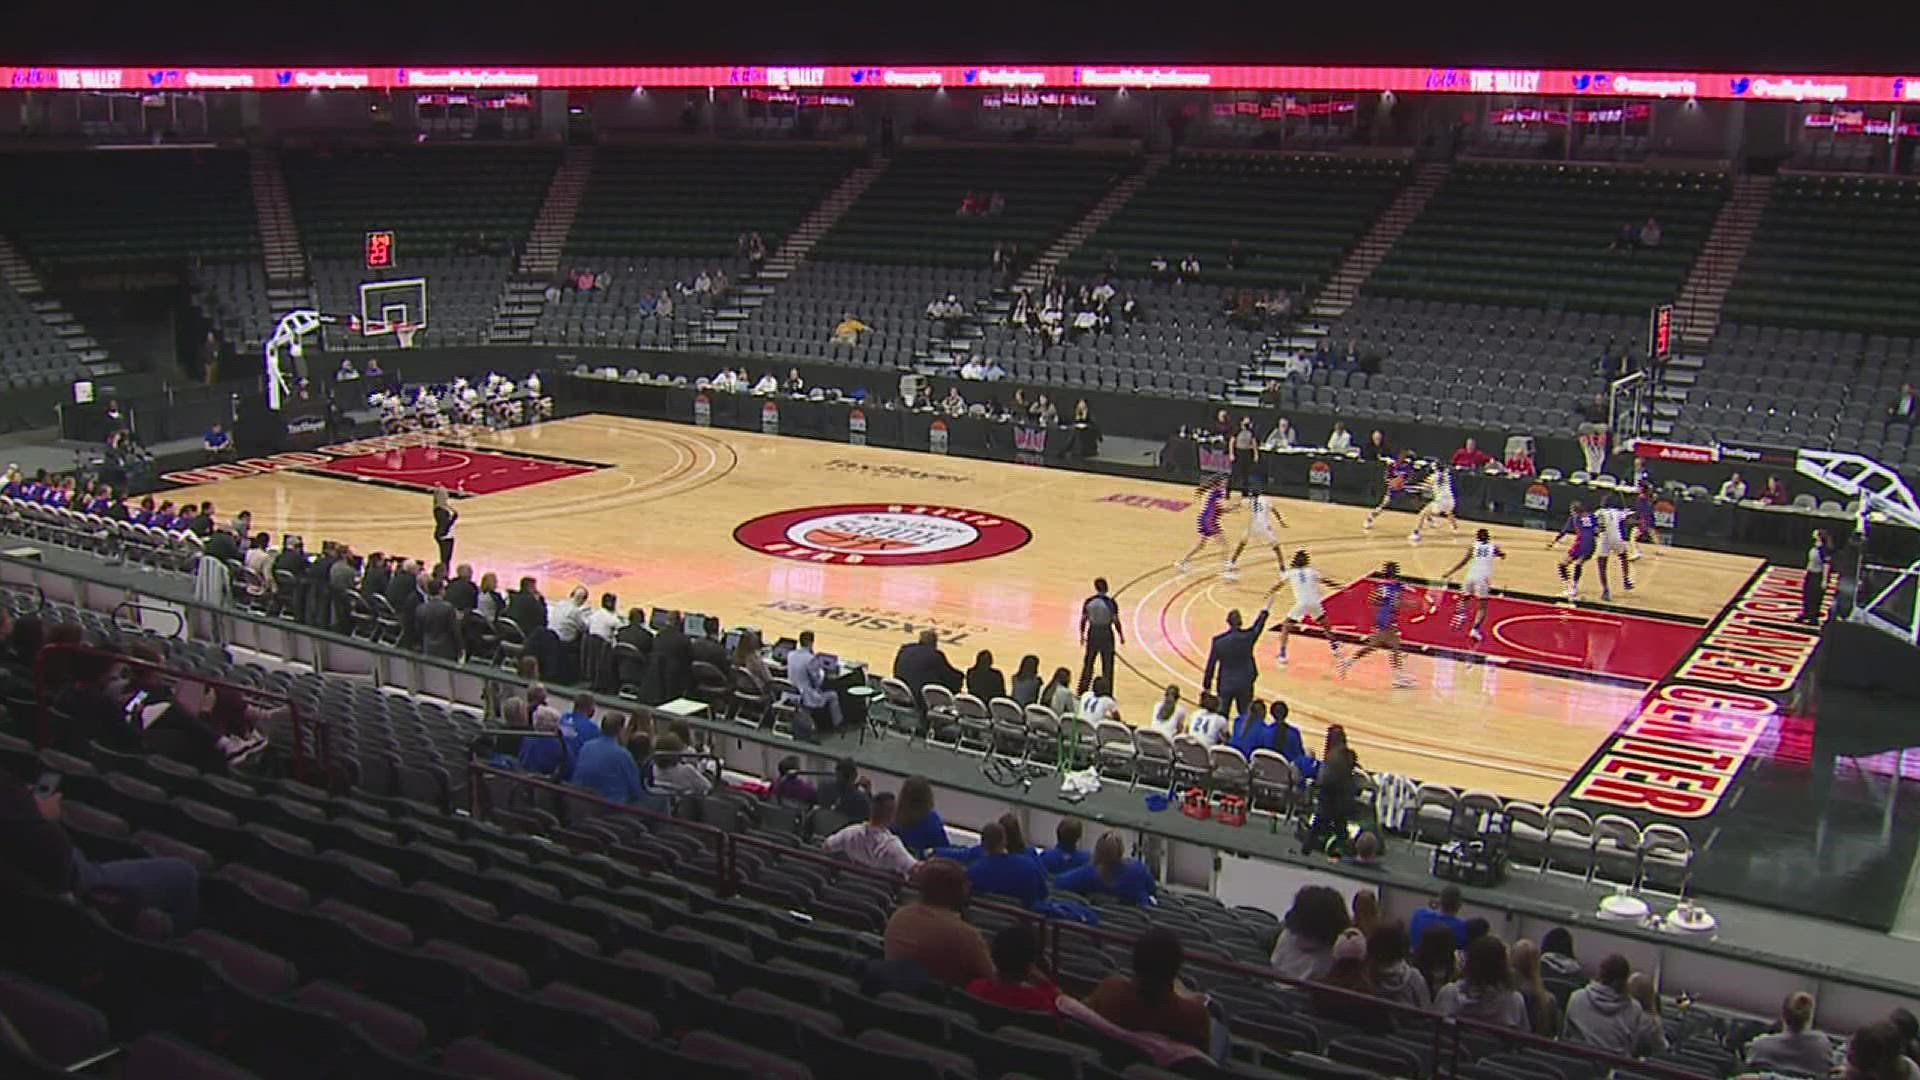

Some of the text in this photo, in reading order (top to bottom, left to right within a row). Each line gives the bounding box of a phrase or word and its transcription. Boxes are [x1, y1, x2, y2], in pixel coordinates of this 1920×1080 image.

[1471, 71, 1494, 92] THE
[1495, 71, 1540, 93] VALLEY
[1569, 684, 1779, 818] CENTER
